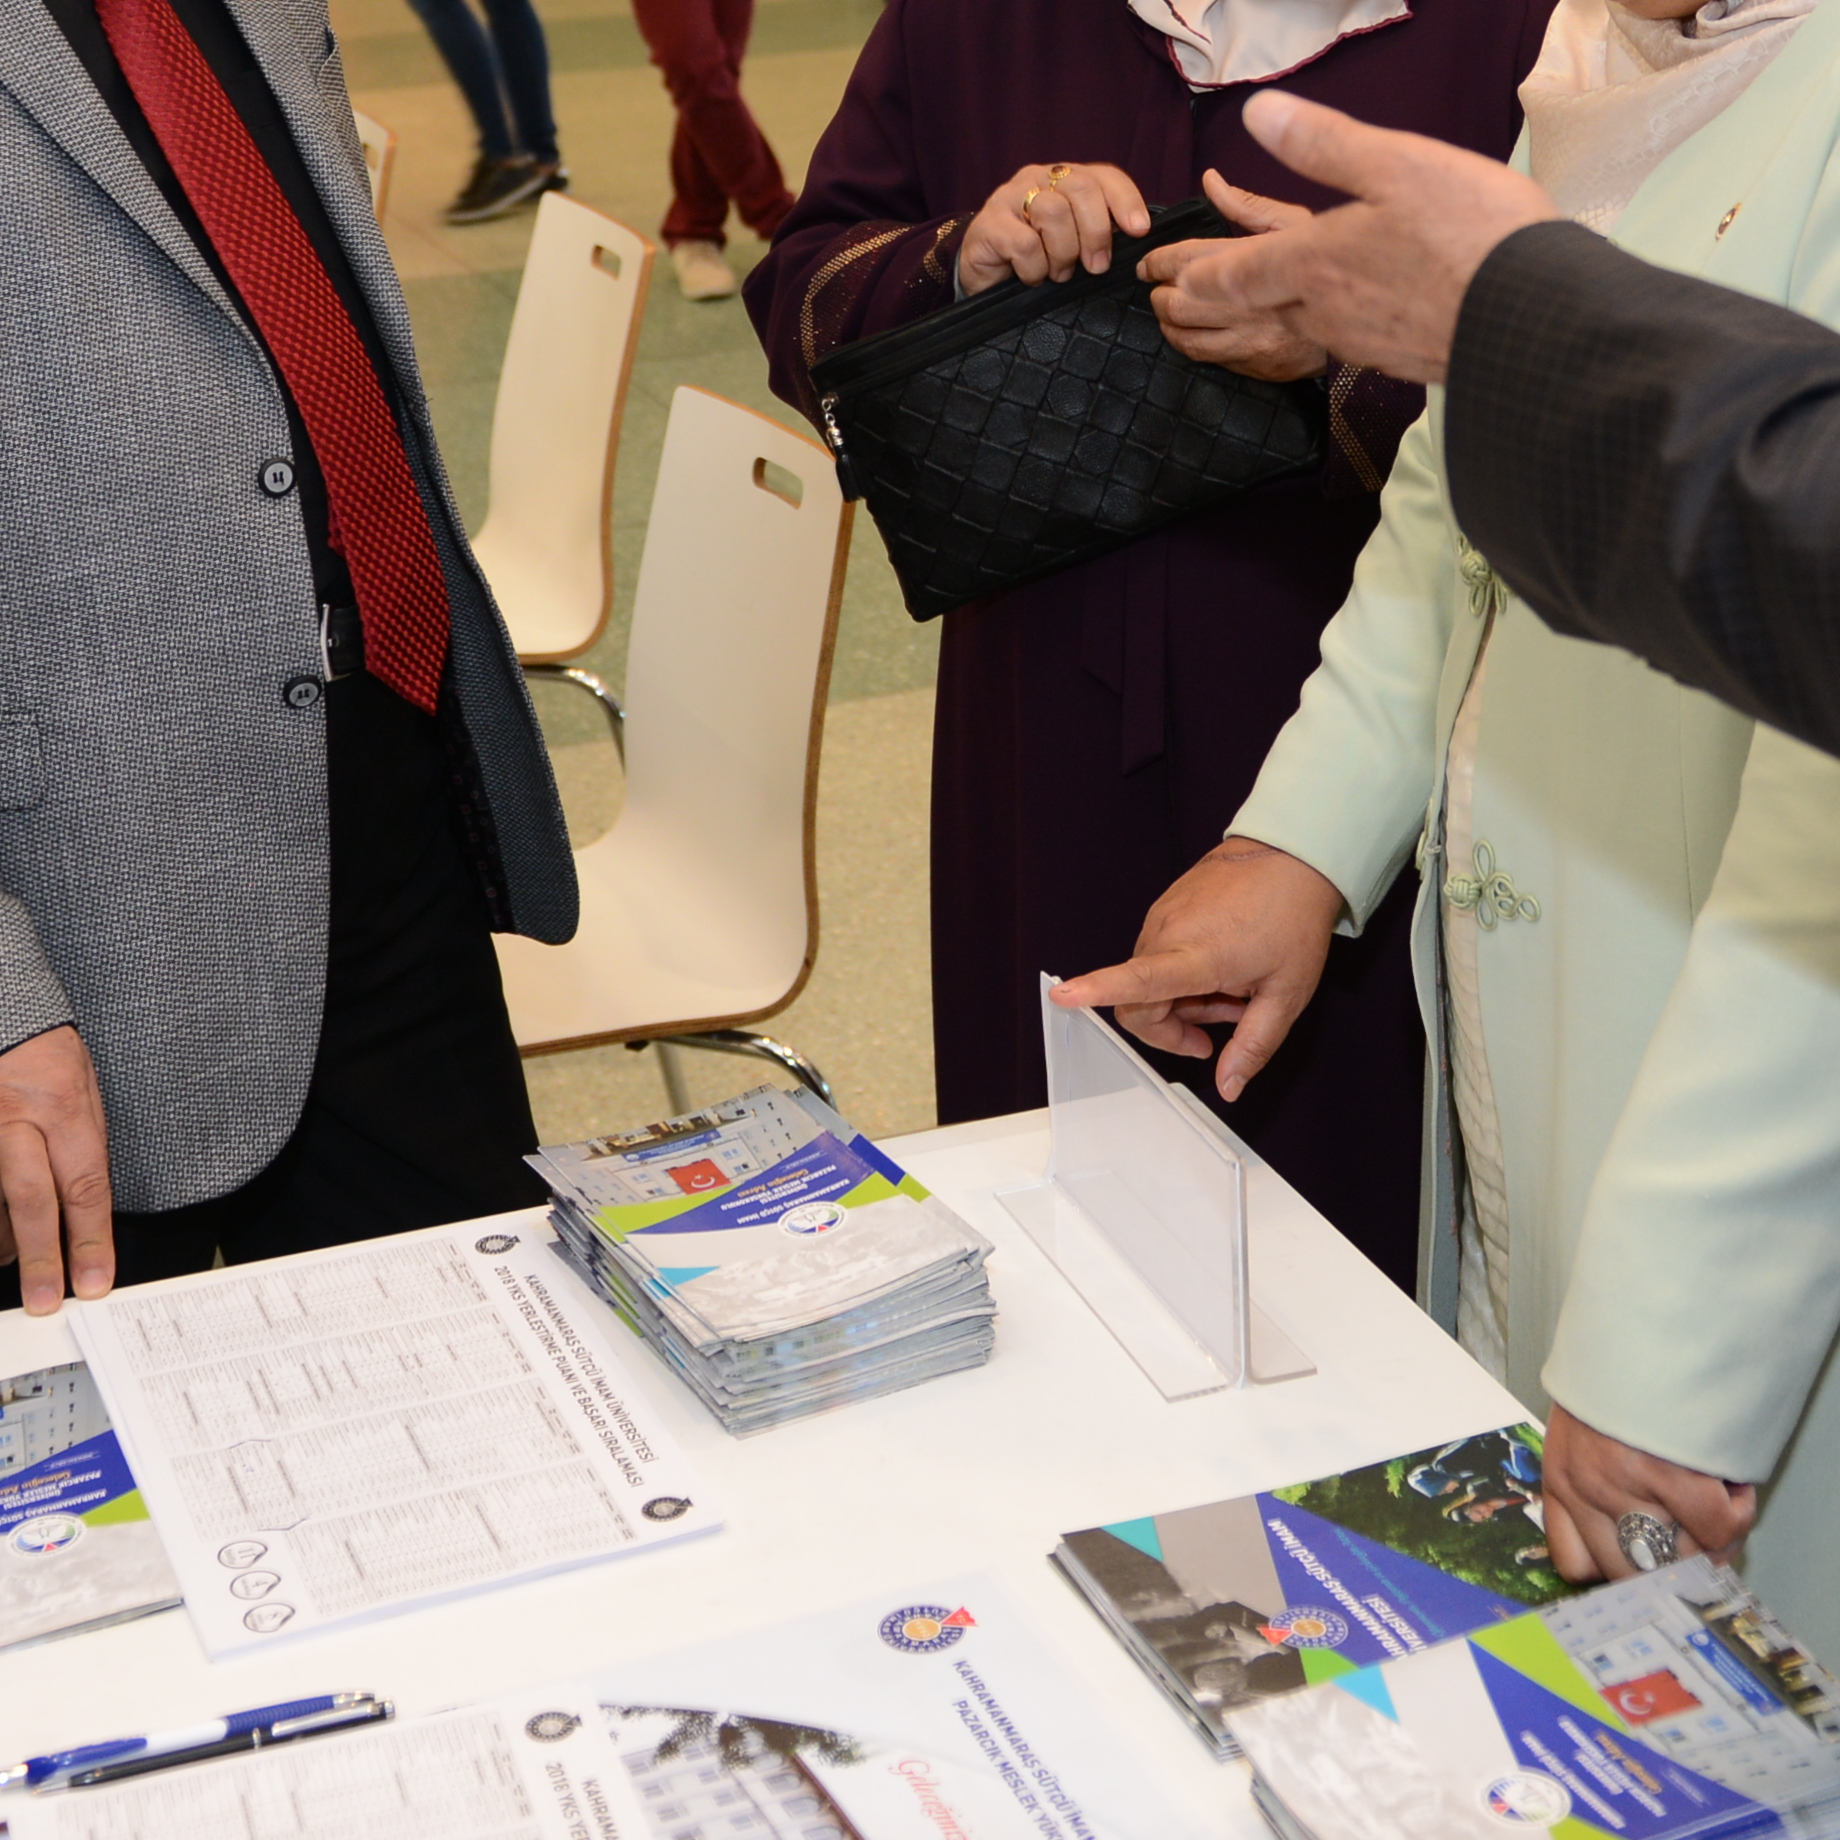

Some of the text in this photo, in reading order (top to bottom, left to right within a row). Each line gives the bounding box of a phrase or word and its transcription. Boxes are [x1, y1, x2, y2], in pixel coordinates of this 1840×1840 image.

[494, 1266, 516, 1285] 2018
[507, 1283, 526, 1301] YKS
[517, 1300, 562, 1356] YERLEŞTİRME
[524, 1274, 659, 1464] KAHRAMANMARAŞ SÜTÇÜ İMAM ÜNİVERSİTESİ
[552, 1355, 580, 1384] PUANI
[570, 1383, 587, 1397] VE
[577, 1396, 609, 1431] BAŞARI
[598, 1430, 645, 1488] SIRALAMASI
[1267, 1518, 1302, 1550] İMAM
[1289, 1545, 1333, 1582] SÜTÇÜ
[1322, 1578, 1408, 1660] HRAMANMARAŞ
[1362, 1595, 1427, 1652] İVERSİTESİ
[952, 1659, 1041, 1769] KAHRAMANMARAŞ
[1032, 1769, 1076, 1812] SÜTÇÜ
[952, 1699, 1007, 1762] PAZARCIK
[995, 1760, 1042, 1814] MESLEK
[545, 1762, 570, 1792] 2018
[558, 1792, 580, 1820] YKS
